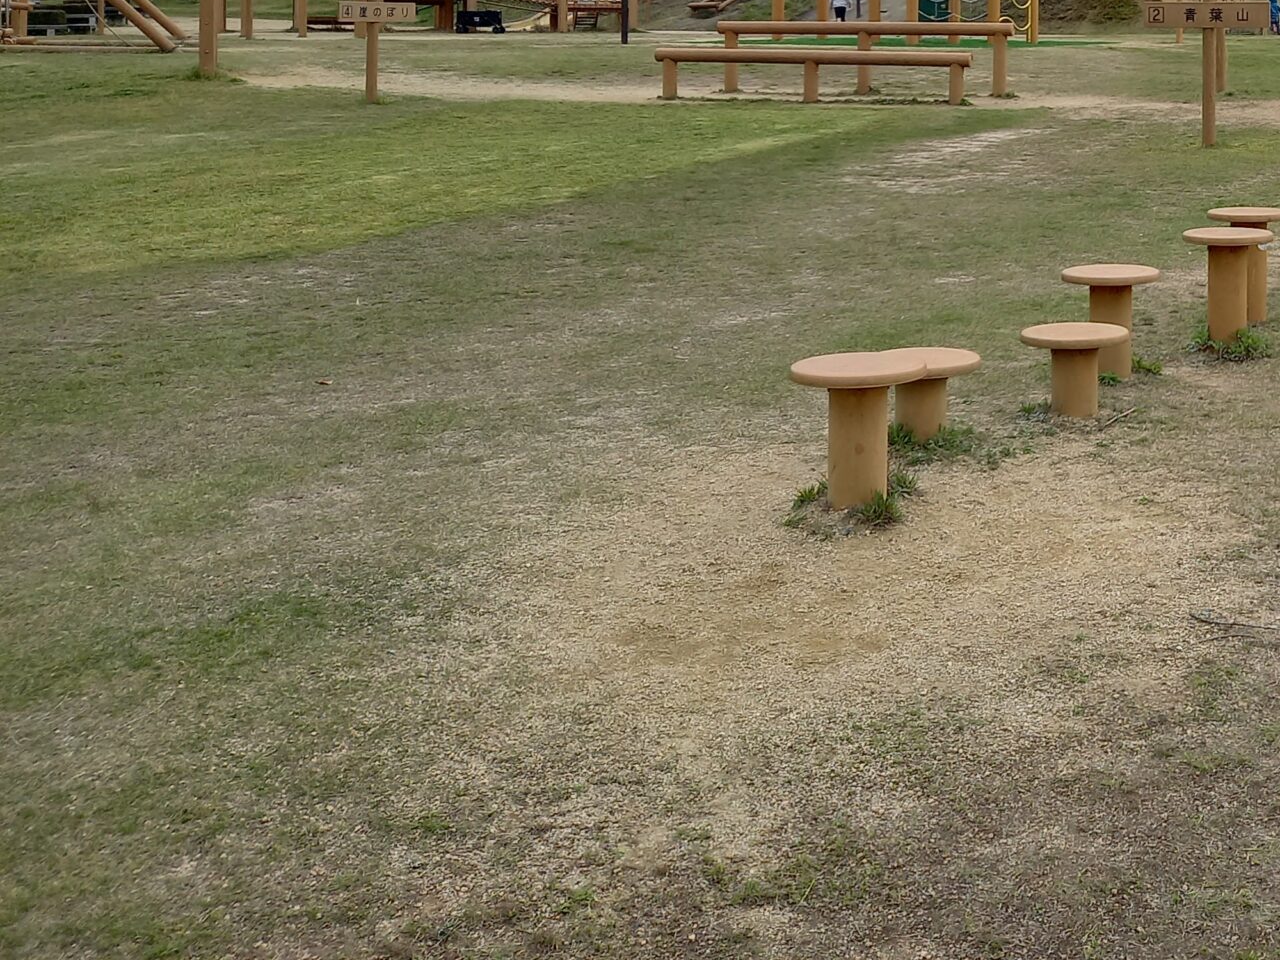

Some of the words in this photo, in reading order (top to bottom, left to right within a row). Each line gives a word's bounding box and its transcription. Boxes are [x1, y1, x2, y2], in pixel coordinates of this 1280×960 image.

[358, 6, 409, 18] 崖のぼり
[1183, 7, 1250, 23] 青葉山
